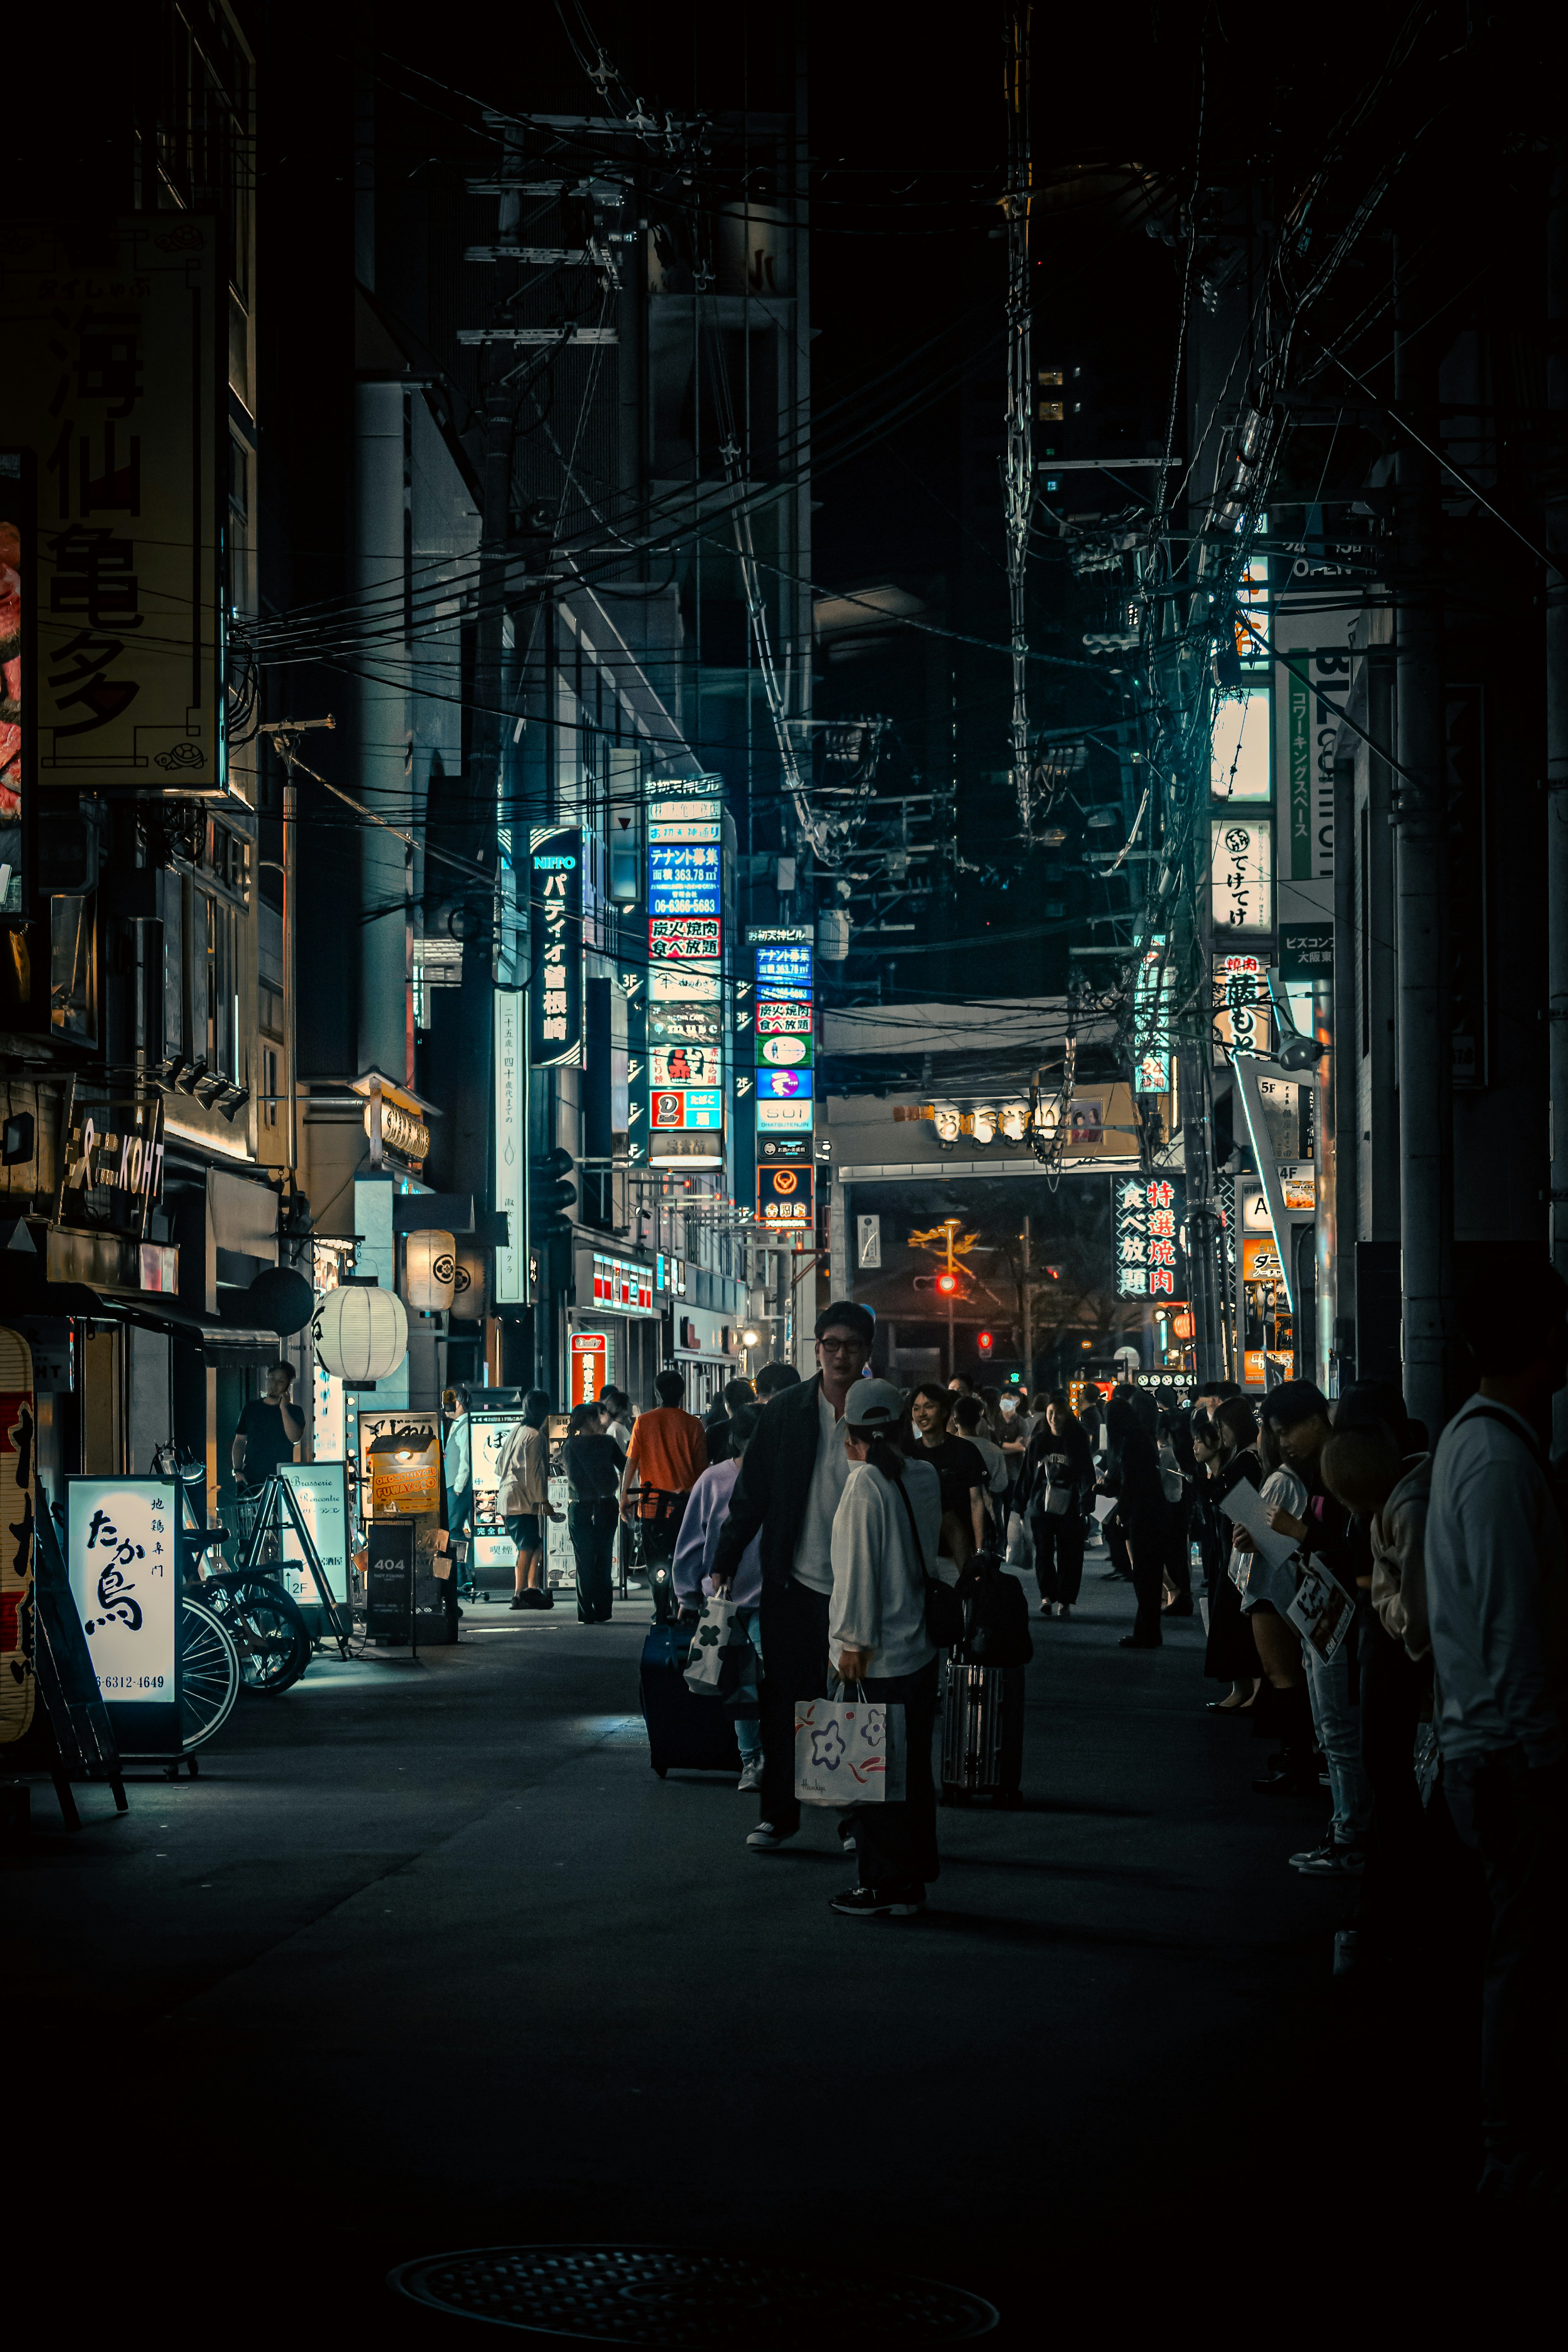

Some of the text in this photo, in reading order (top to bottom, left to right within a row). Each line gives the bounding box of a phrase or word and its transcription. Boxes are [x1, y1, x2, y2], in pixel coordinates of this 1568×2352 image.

[47, 305, 145, 734] 海仙亀多
[1292, 693, 1308, 837] コワーキングスペース
[650, 847, 719, 866] テナント募集
[675, 869, 704, 881] 363.78
[1227, 855, 1250, 927] てけてけ
[655, 899, 715, 913] 06-6366-5683
[653, 920, 718, 938] 炭火焼肉
[748, 929, 805, 941] お初天神ビル
[652, 940, 718, 956] 食べ放題
[622, 973, 638, 988] 3F
[760, 1018, 809, 1031] 食べ放題
[736, 1078, 748, 1088] 2F
[1261, 1082, 1276, 1094] 5F
[1280, 1167, 1297, 1179] 4F
[1117, 1180, 1147, 1295] 食べ放題
[1147, 1180, 1176, 1294] 特選焼肉
[290, 1475, 333, 1487] Brasserie
[375, 1466, 437, 1486] OKONOMIYAKI
[376, 1478, 437, 1499] FUWATORO
[300, 1492, 341, 1502] Rencontre
[477, 1527, 506, 1535] 完全個
[490, 1545, 518, 1555] 喫煙
[374, 1559, 405, 1570] 404
[84, 1509, 146, 1636] たか鳥
[292, 1583, 308, 1594] 2F
